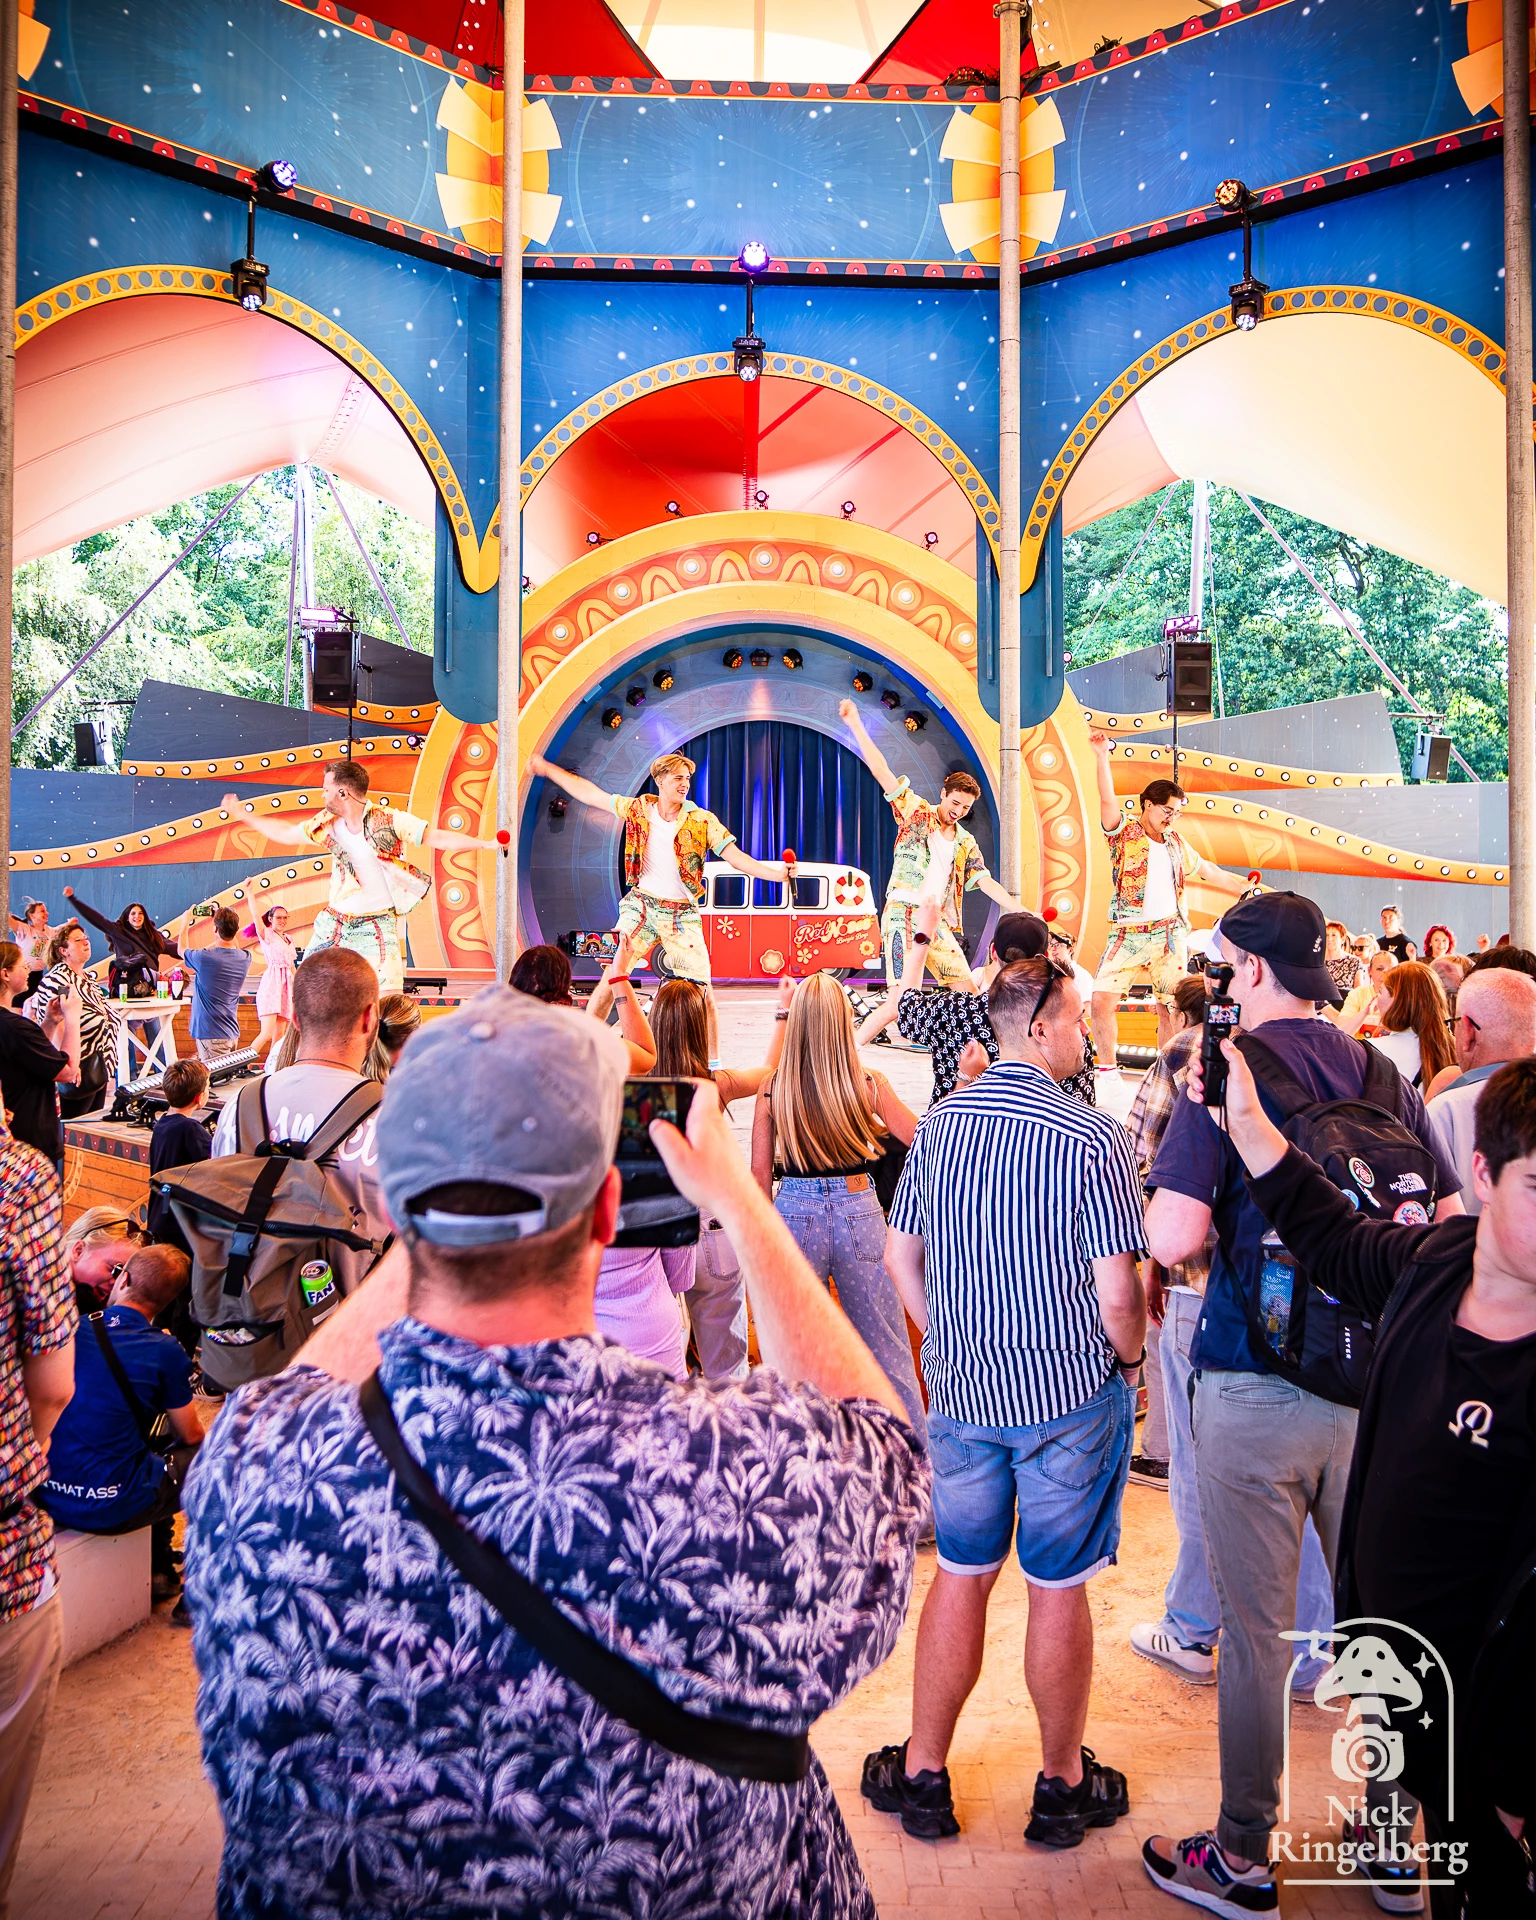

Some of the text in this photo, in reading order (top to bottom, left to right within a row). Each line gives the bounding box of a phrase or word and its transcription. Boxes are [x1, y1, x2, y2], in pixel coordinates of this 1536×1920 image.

[794, 920, 832, 944] Red
[1389, 1179, 1414, 1190] NORTH
[1398, 1173, 1412, 1181] THE
[1399, 1186, 1415, 1195] FACE
[307, 1281, 335, 1303] FAN
[48, 1480, 84, 1498] THAT
[86, 1486, 118, 1499] ASS
